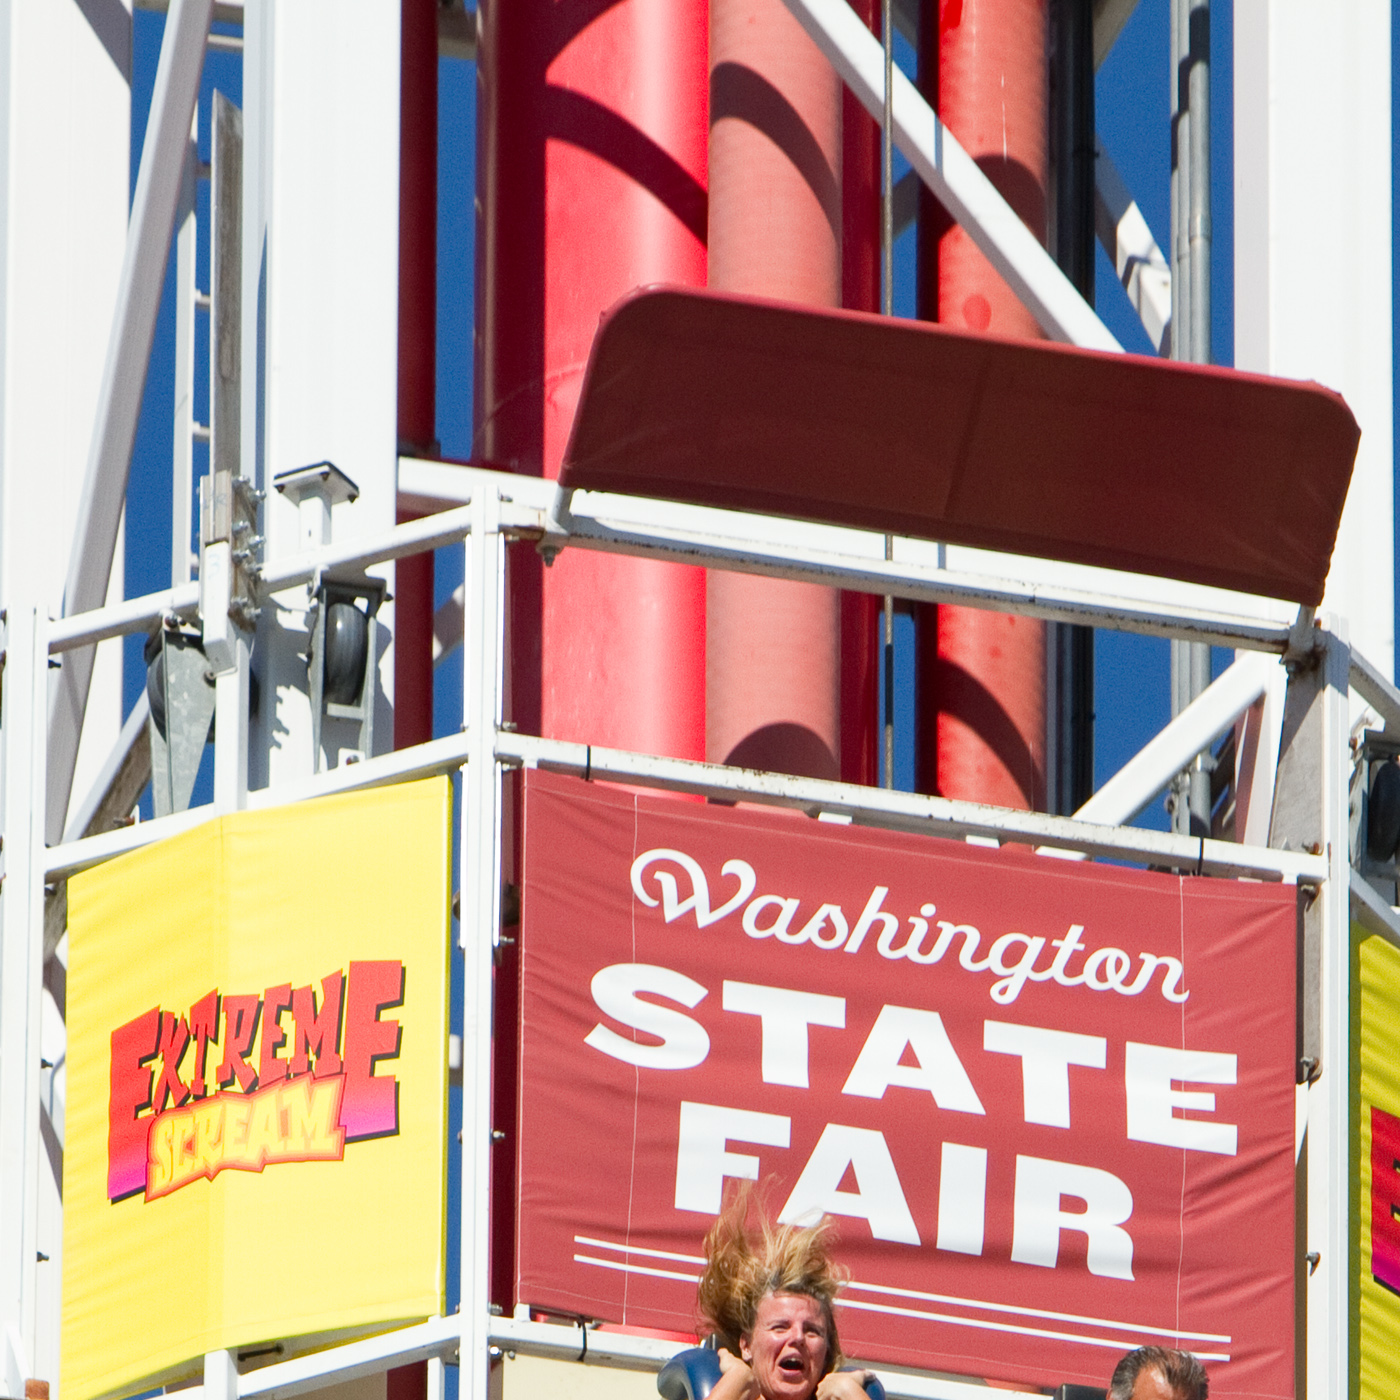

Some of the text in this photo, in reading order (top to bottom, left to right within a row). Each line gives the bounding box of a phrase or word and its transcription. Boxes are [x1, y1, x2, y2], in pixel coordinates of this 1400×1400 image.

[630, 848, 1190, 1005] Washington
[108, 960, 405, 1204] EXTREME
[145, 1072, 347, 1202] SCREAM
[584, 962, 1239, 1156] STATE
[674, 1100, 1136, 1282] FAIR
